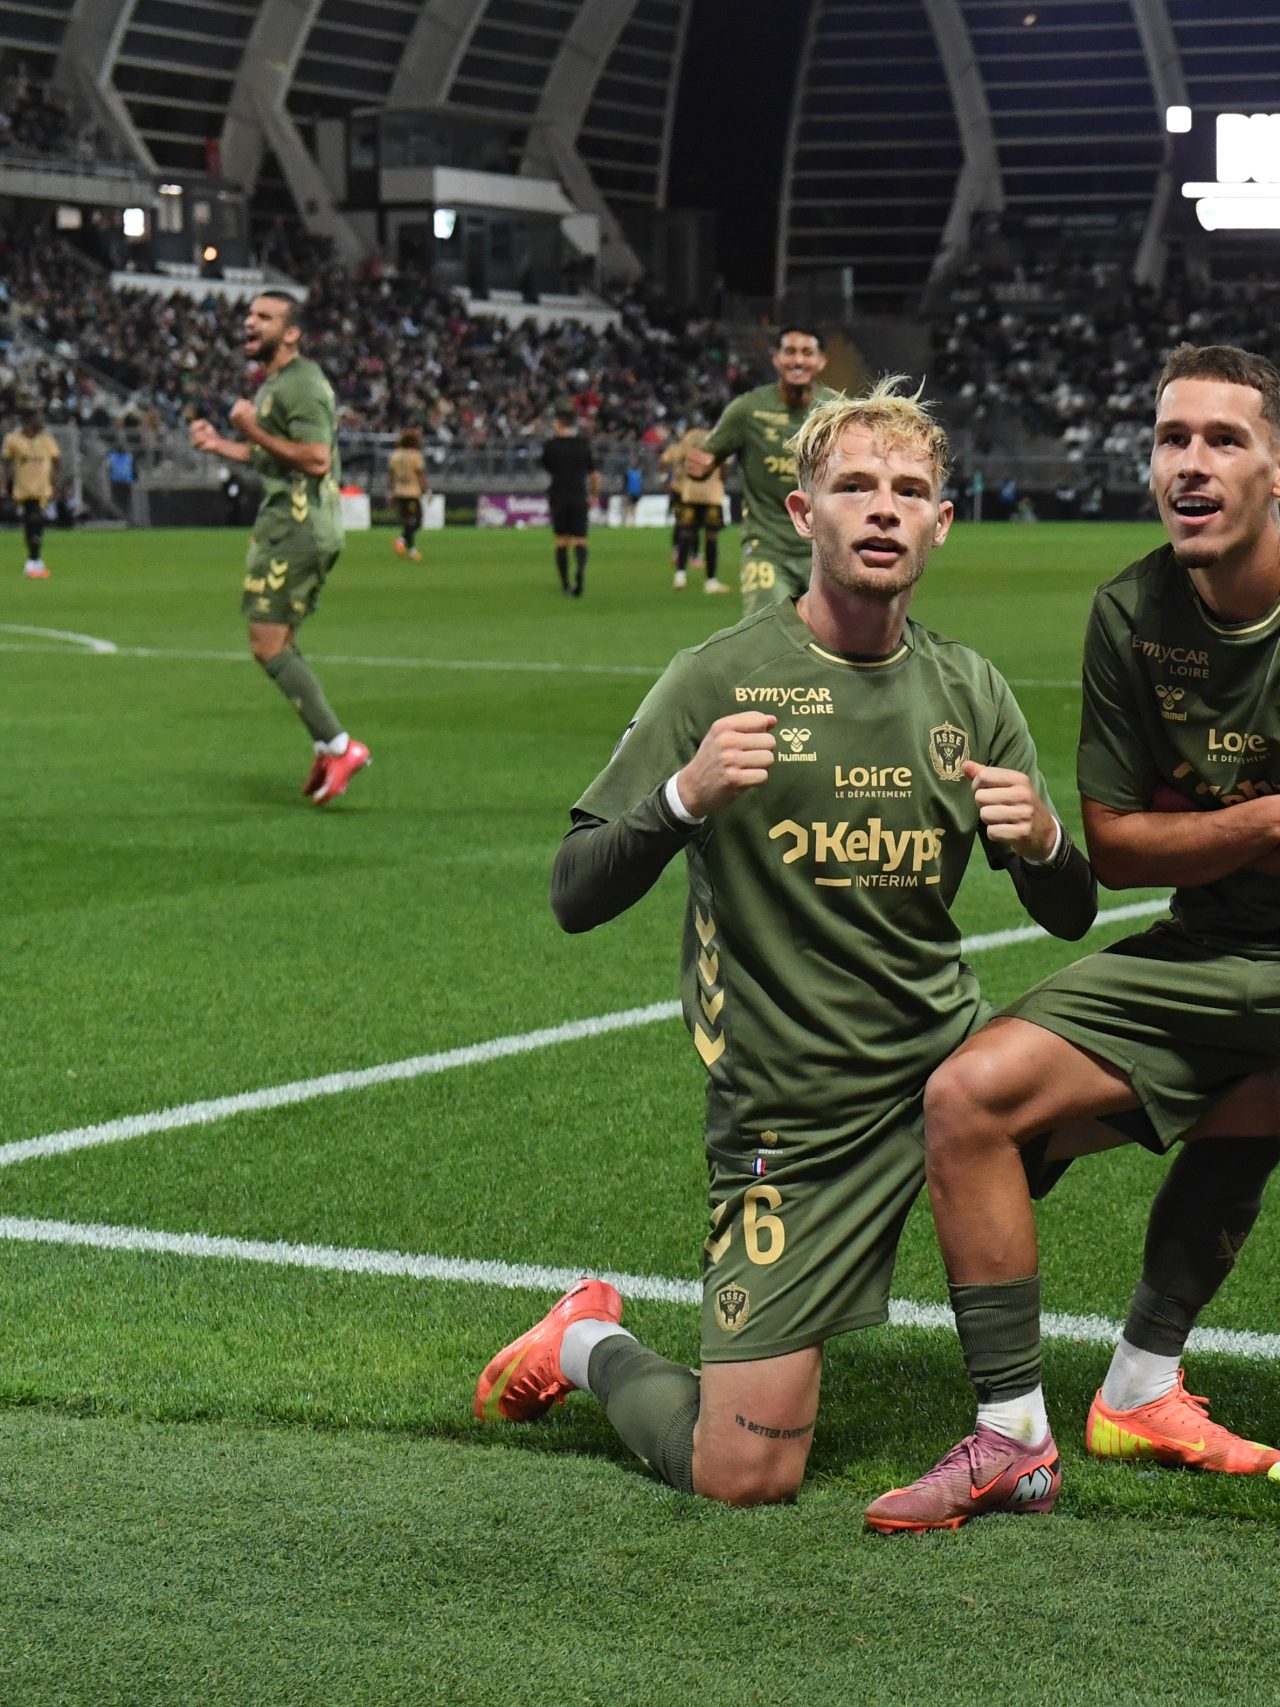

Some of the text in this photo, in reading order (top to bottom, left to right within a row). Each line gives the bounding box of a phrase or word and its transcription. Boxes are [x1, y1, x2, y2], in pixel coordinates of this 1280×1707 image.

[741, 560, 776, 593] 29
[1169, 665, 1209, 679] LOIRE
[791, 703, 834, 715] LOIRE
[936, 733, 963, 747] ASSE
[778, 751, 818, 762] hummel
[1207, 754, 1217, 762] LE
[835, 765, 913, 788] Loire
[835, 789, 912, 799] LE DÉPARTEMENT
[812, 818, 946, 872] Kelyps
[856, 874, 918, 888] INTERIM
[743, 1184, 786, 1266] 6
[720, 1291, 745, 1303] ASSE
[747, 1420, 781, 1440] BETTER
[1091, 1413, 1153, 1458] NIKE
